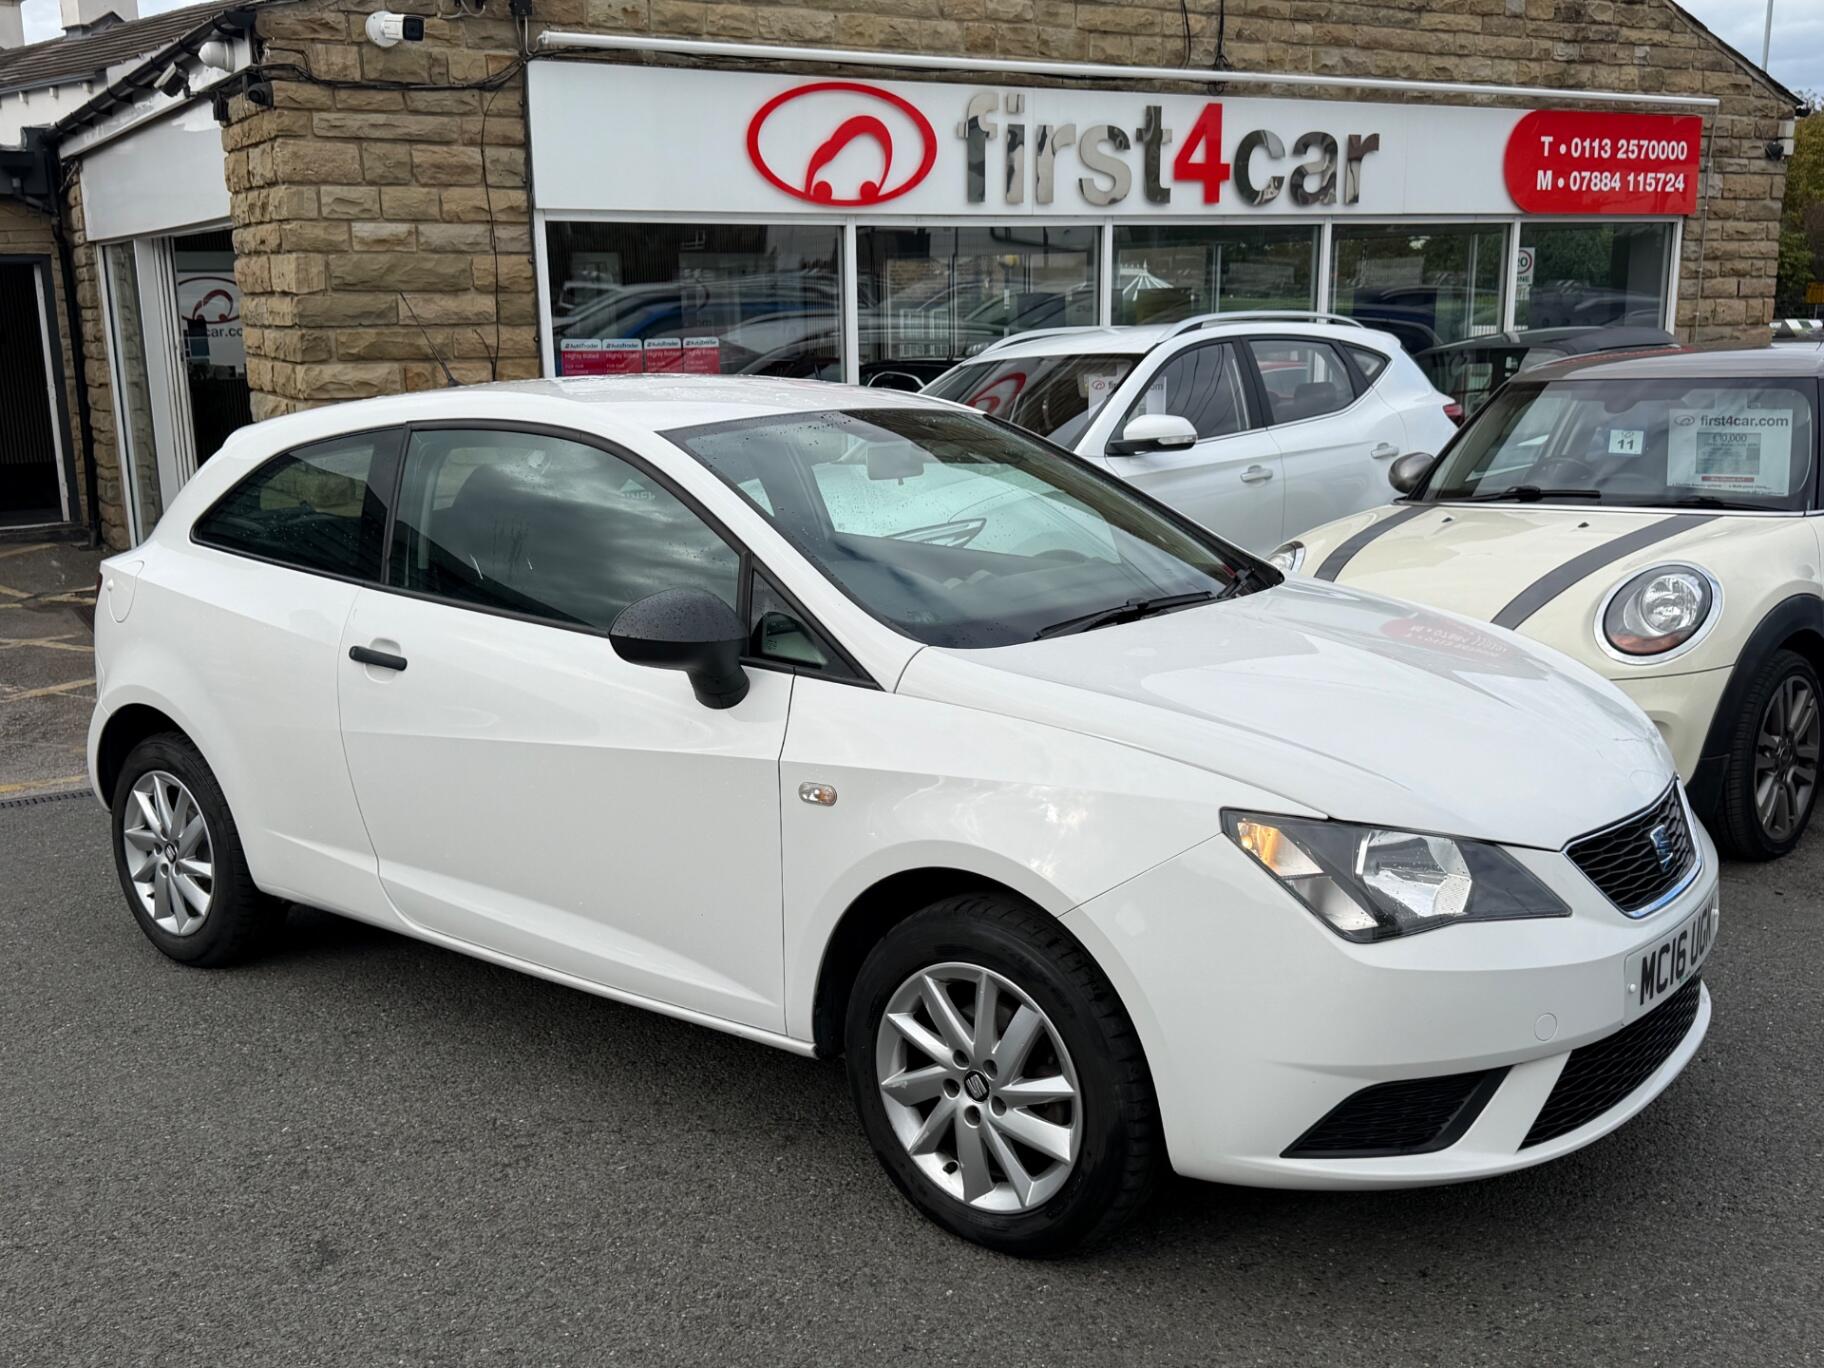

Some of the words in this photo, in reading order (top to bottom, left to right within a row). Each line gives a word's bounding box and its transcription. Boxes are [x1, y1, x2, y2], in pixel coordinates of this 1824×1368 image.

[957, 92, 1380, 205] first4car
[1540, 135, 1554, 158] T
[1570, 137, 1612, 159] 0113
[1616, 139, 1688, 161] 2570000
[1536, 169, 1553, 191] M
[1569, 170, 1621, 192] 07884
[1626, 171, 1685, 193] 115724
[1700, 415, 1789, 427] first4car.com
[1616, 439, 1634, 451] 11
[1640, 930, 1687, 1005] MC16
